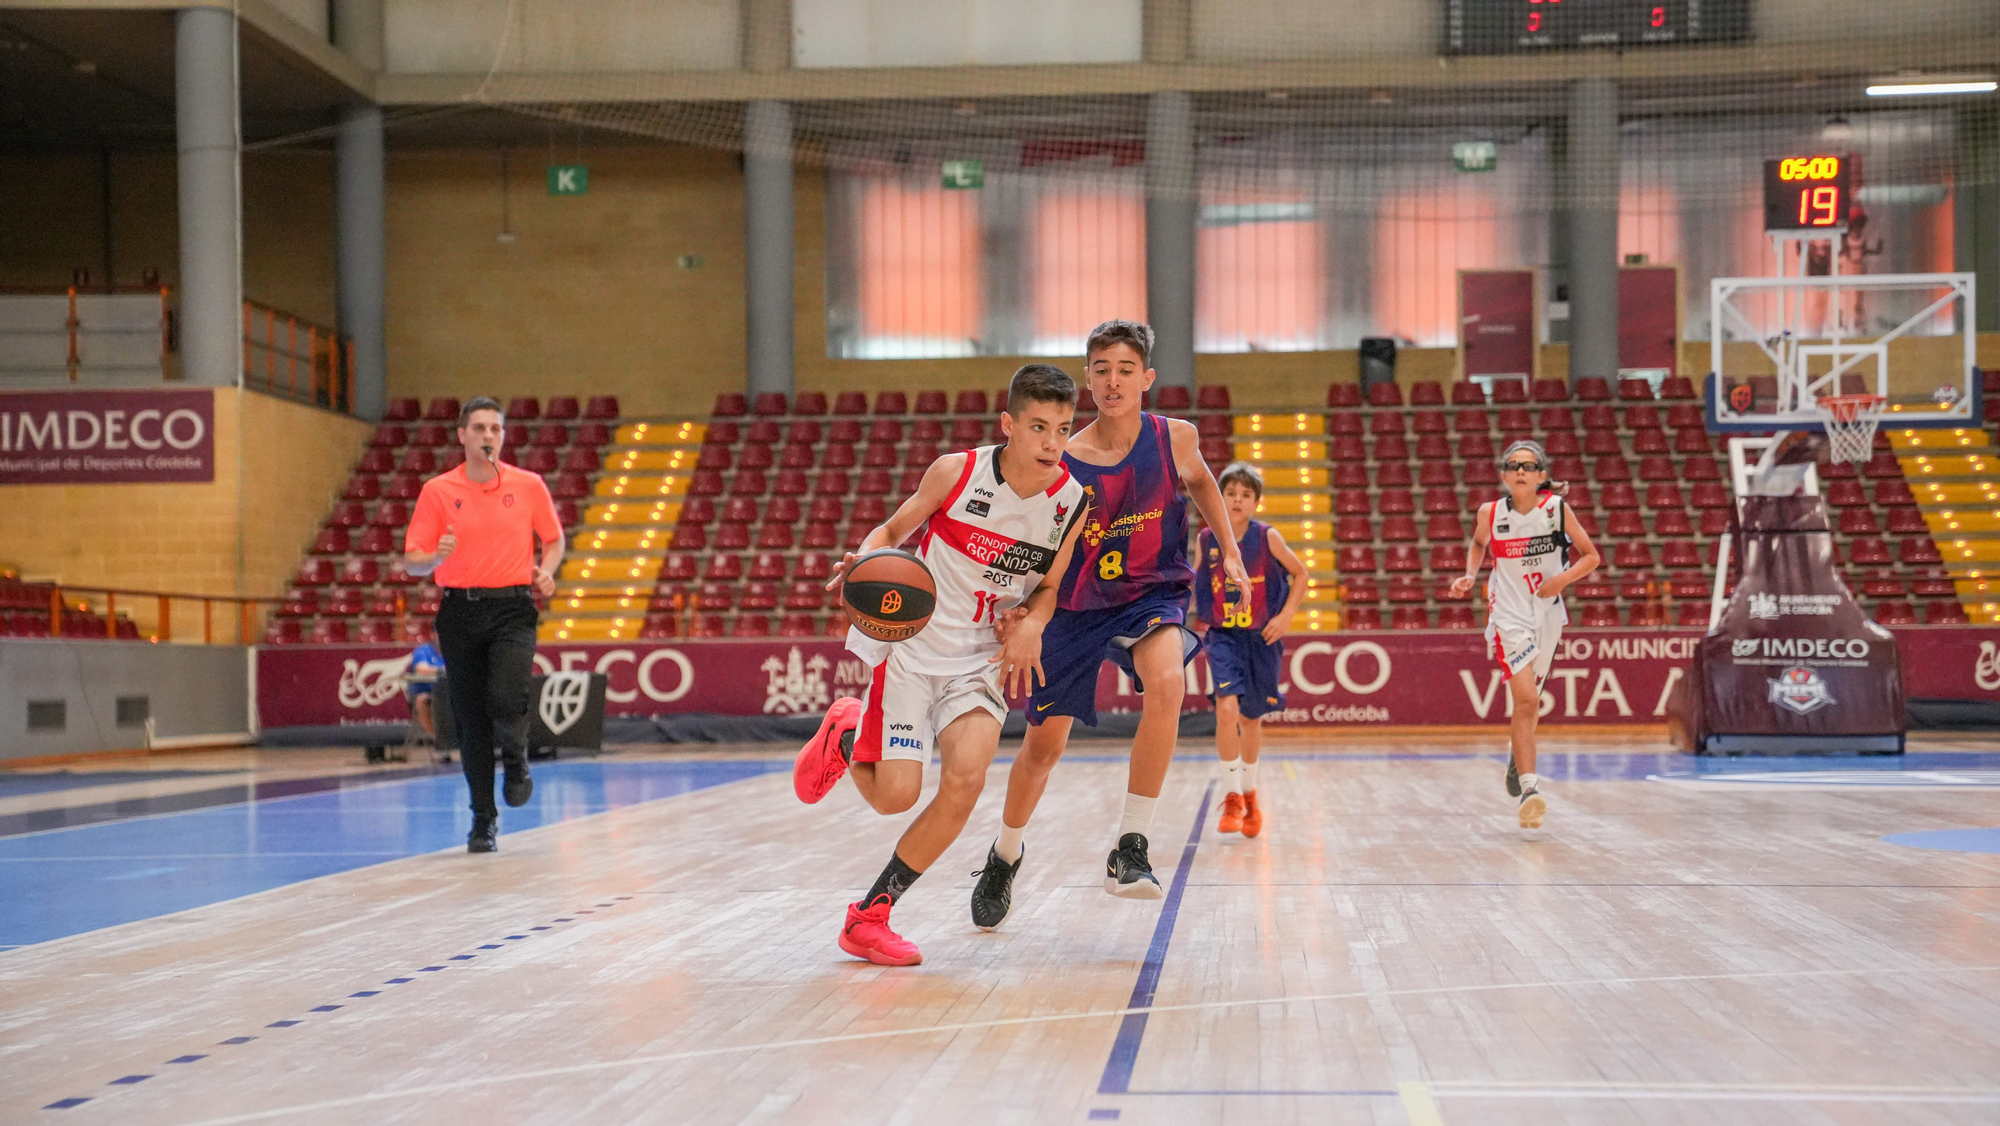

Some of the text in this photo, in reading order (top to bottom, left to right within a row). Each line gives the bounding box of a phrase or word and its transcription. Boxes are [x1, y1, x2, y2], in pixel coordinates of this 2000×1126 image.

[1780, 157, 1839, 180] 05:00
[558, 169, 576, 192] K
[1799, 187, 1840, 225] 19
[1, 409, 204, 450] IMDECO
[974, 487, 995, 499] vive
[1030, 550, 1043, 562] CB
[1099, 550, 1123, 580] 8
[1521, 557, 1542, 567] 2031
[982, 570, 1013, 587] 2031
[1523, 572, 1543, 595] 12
[1222, 602, 1253, 628] 58
[1510, 644, 1535, 667] PULEVA
[1762, 637, 1870, 659] IMDECO
[1312, 704, 1390, 722] Córdoba
[890, 723, 914, 731] vive
